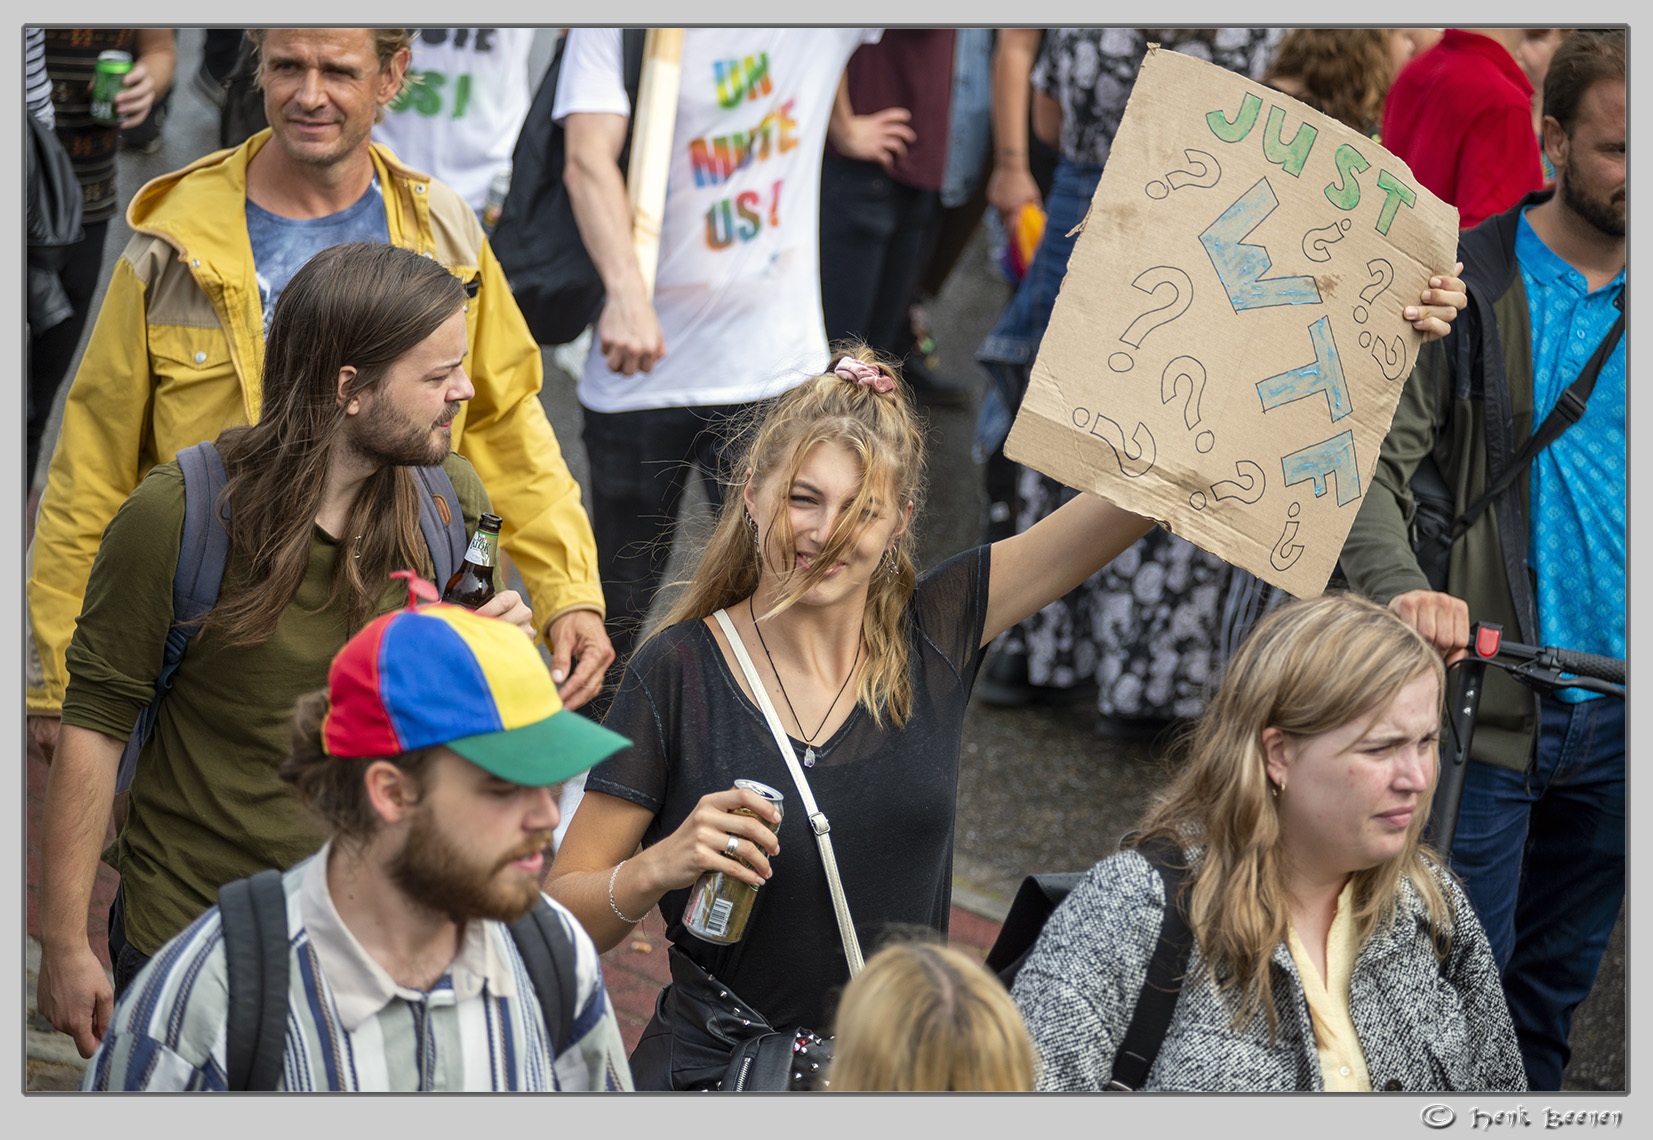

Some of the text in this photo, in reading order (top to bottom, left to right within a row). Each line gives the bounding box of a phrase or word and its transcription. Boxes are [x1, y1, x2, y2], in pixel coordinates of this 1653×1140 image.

[713, 52, 774, 110] UN
[689, 97, 800, 190] MUTE
[1205, 91, 1418, 237] JUST
[705, 179, 784, 252] US!
[1197, 175, 1362, 507] WTF
